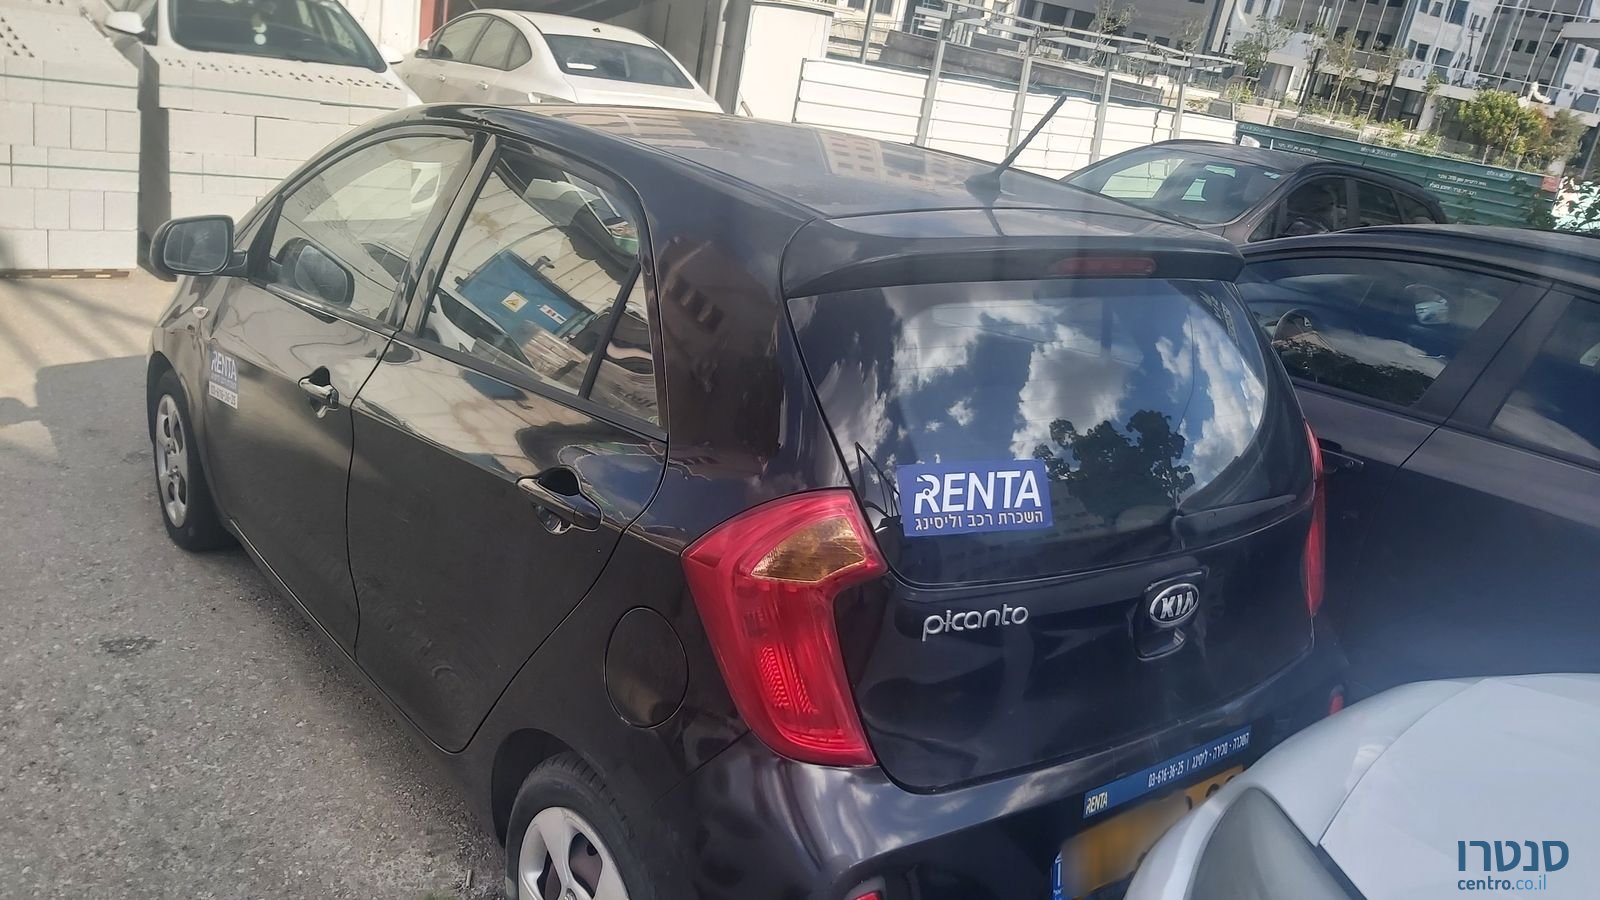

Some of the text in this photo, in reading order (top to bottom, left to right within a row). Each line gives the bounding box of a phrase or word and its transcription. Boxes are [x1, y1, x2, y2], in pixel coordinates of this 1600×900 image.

[211, 351, 237, 381] RENTA
[913, 470, 1042, 514] RENTA
[915, 511, 1043, 531] השכרת רכב וליסינג
[1160, 591, 1194, 619] KIA
[922, 604, 1029, 642] picanto
[1192, 749, 1208, 769] ליסינג
[1212, 742, 1229, 760] מכירה
[1148, 760, 1185, 788] 03-616-36-25
[1085, 792, 1108, 815] RENTA
